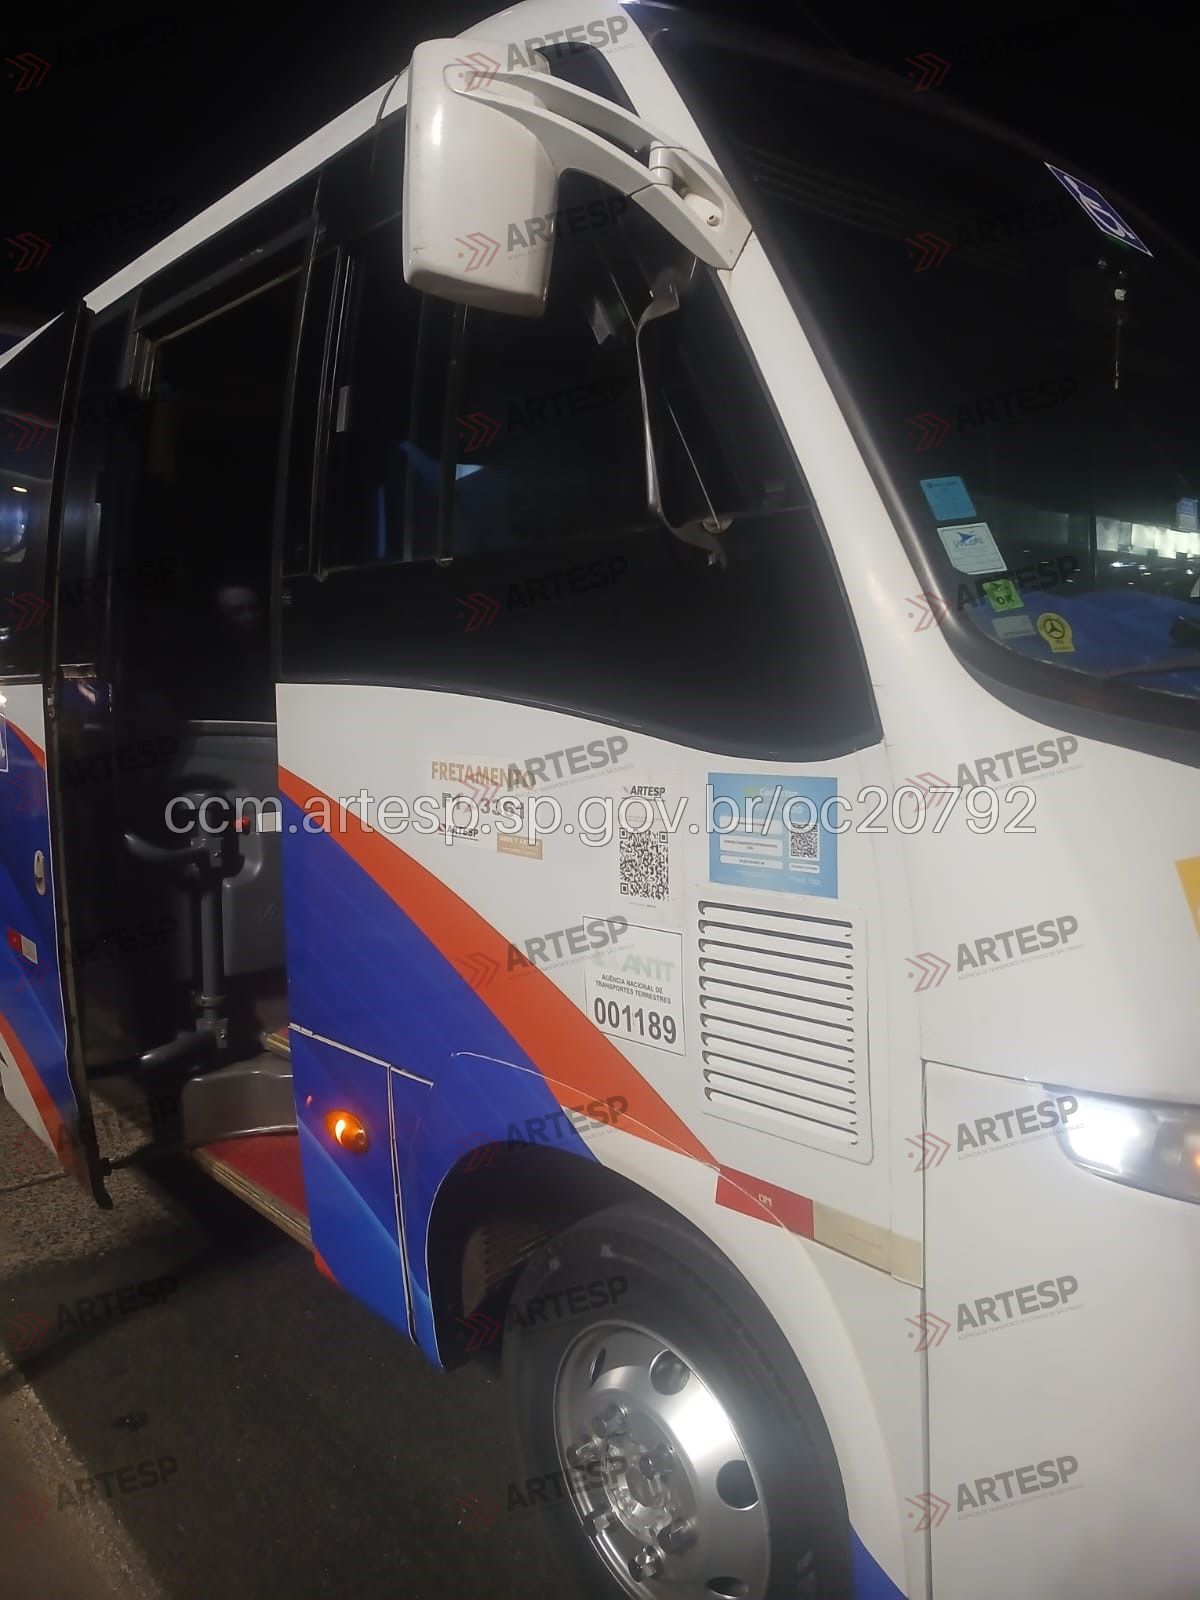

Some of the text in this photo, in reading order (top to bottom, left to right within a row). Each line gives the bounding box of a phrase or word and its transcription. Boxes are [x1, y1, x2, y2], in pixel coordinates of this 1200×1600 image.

[431, 761, 536, 791] FRETAMENTO
[630, 785, 666, 797] ARTESP
[621, 953, 675, 982] ANTT
[595, 980, 671, 1005] TRANSPORTES TERRESTRES
[602, 974, 625, 985] AGÊNCIA
[626, 980, 654, 992] NACIONAL
[594, 997, 677, 1044] 001189
